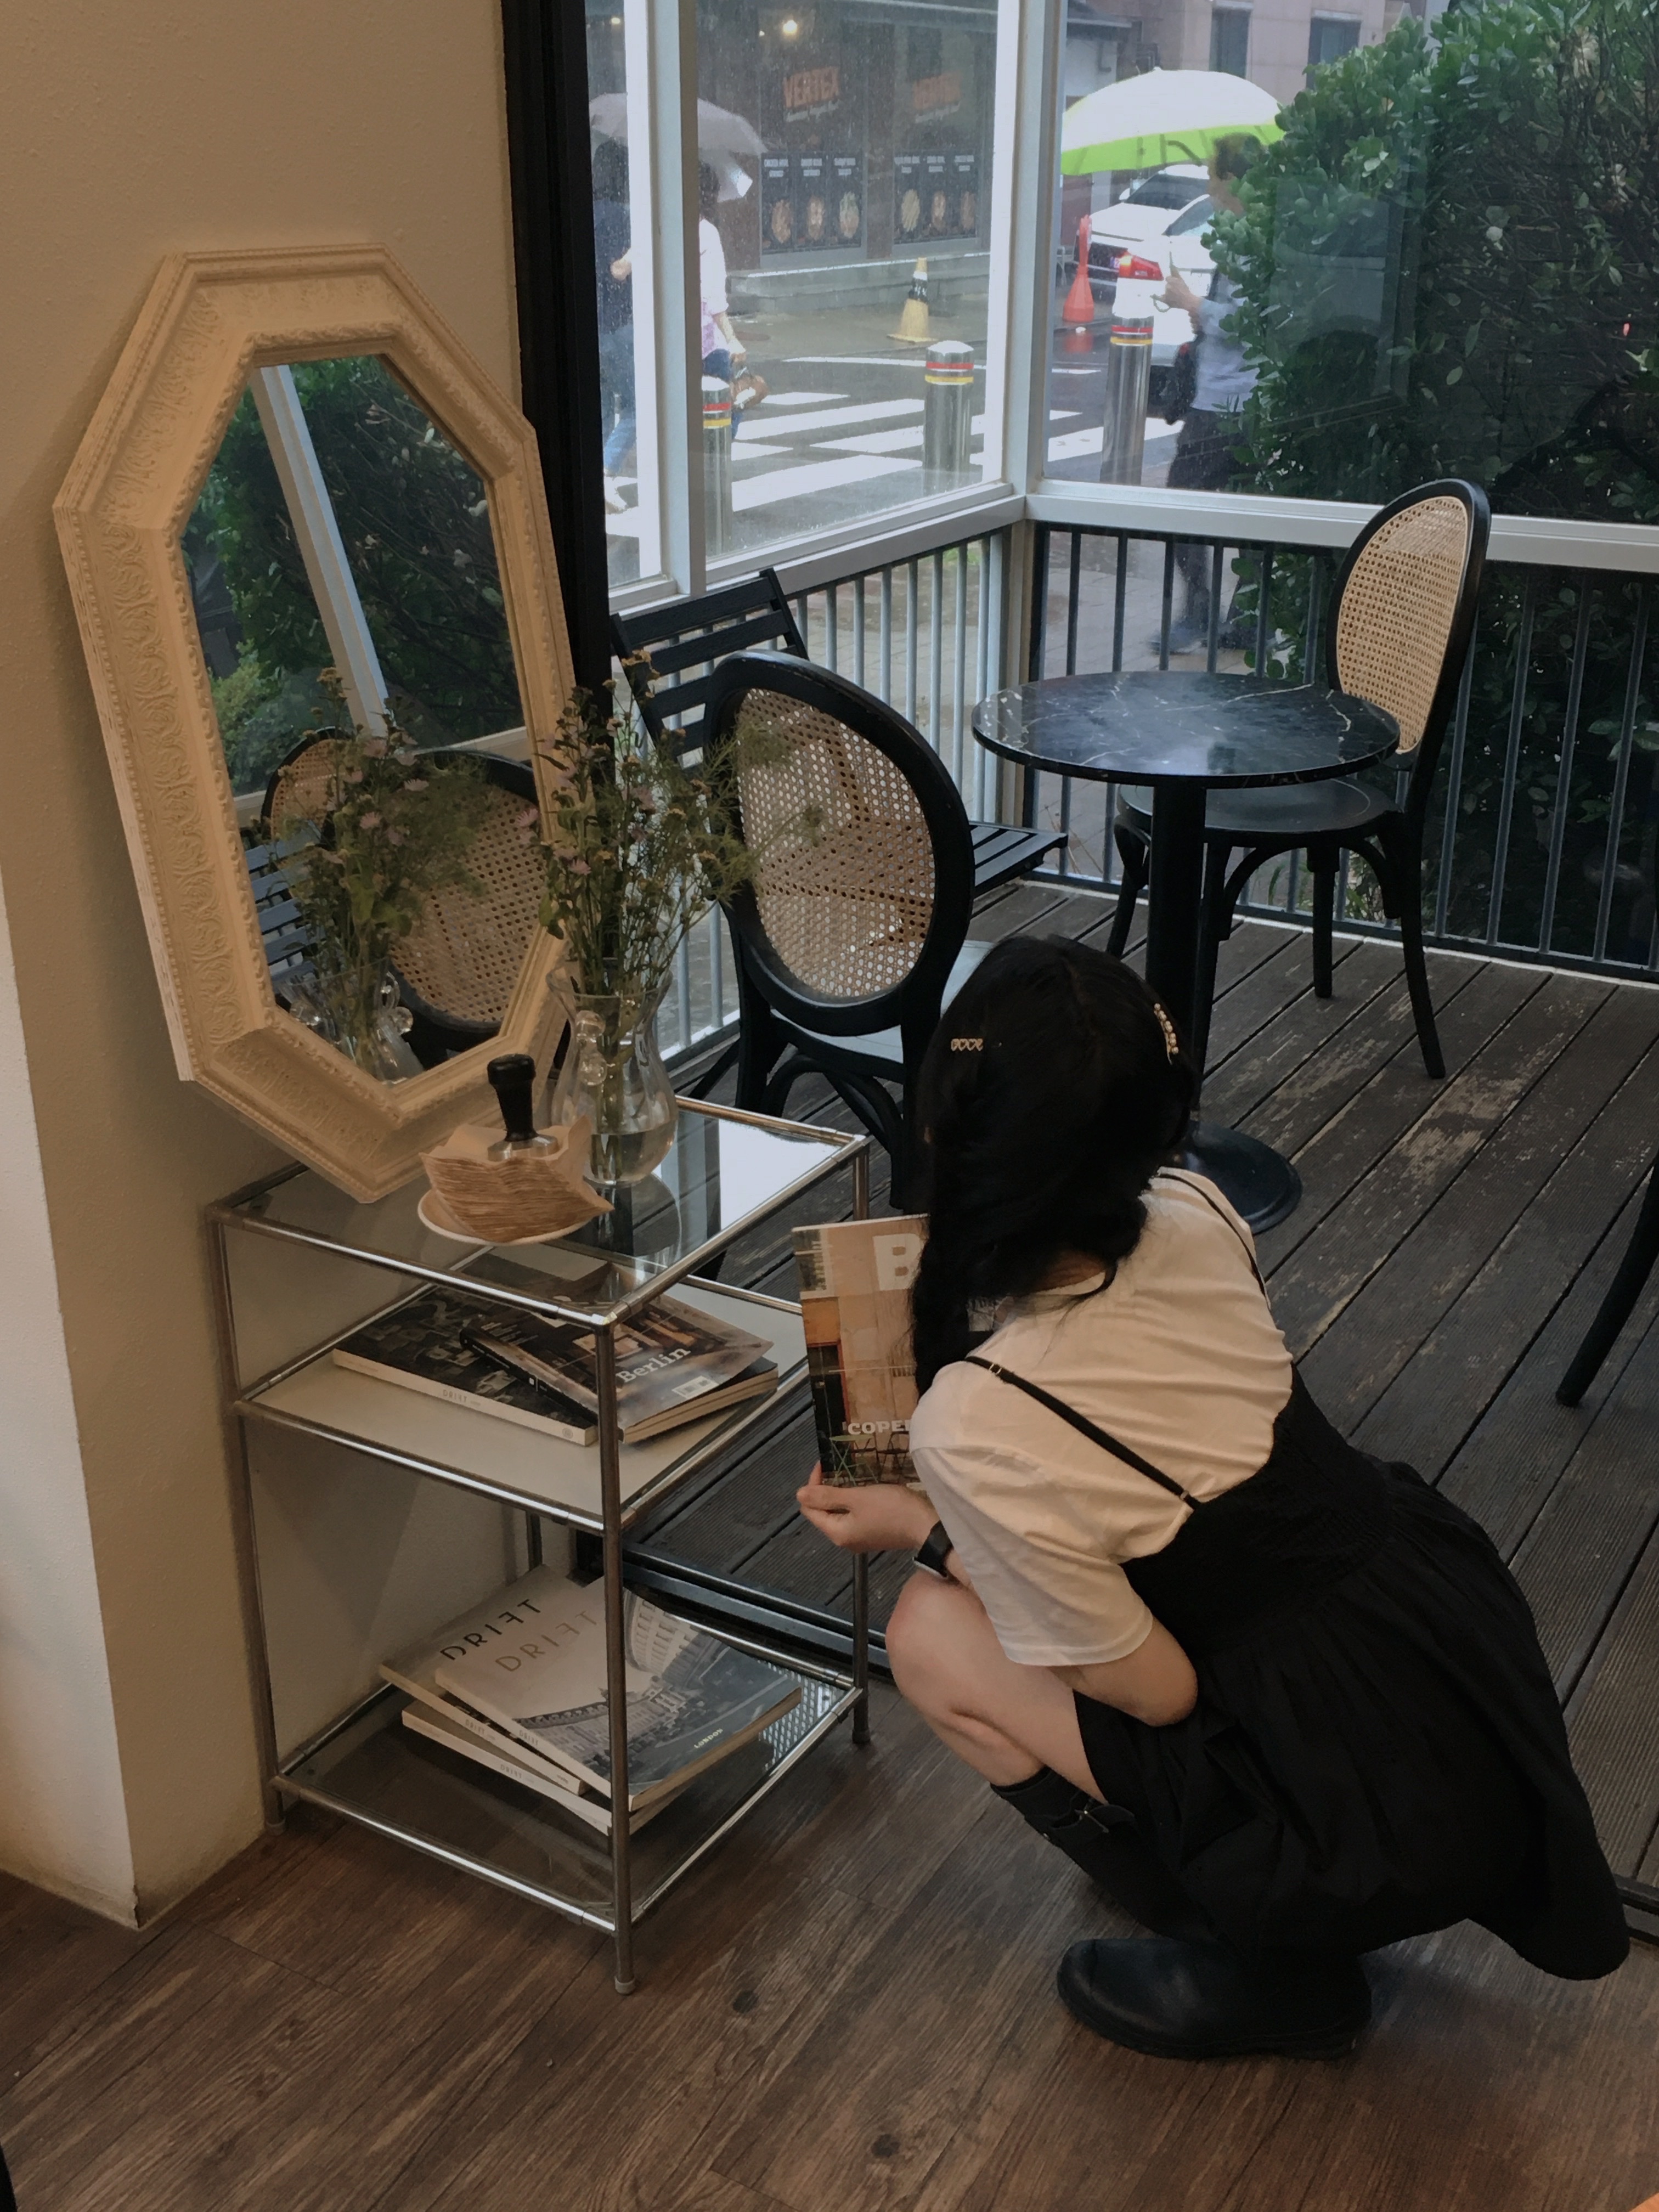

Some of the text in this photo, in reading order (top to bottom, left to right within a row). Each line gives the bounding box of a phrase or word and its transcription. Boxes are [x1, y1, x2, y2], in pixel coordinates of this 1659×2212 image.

[872, 1233, 925, 1290] B
[616, 1348, 691, 1383] Berlin
[440, 1599, 541, 1661] DRIFT
[495, 1611, 597, 1672] DRIFT
[693, 1728, 724, 1748] LONDON
